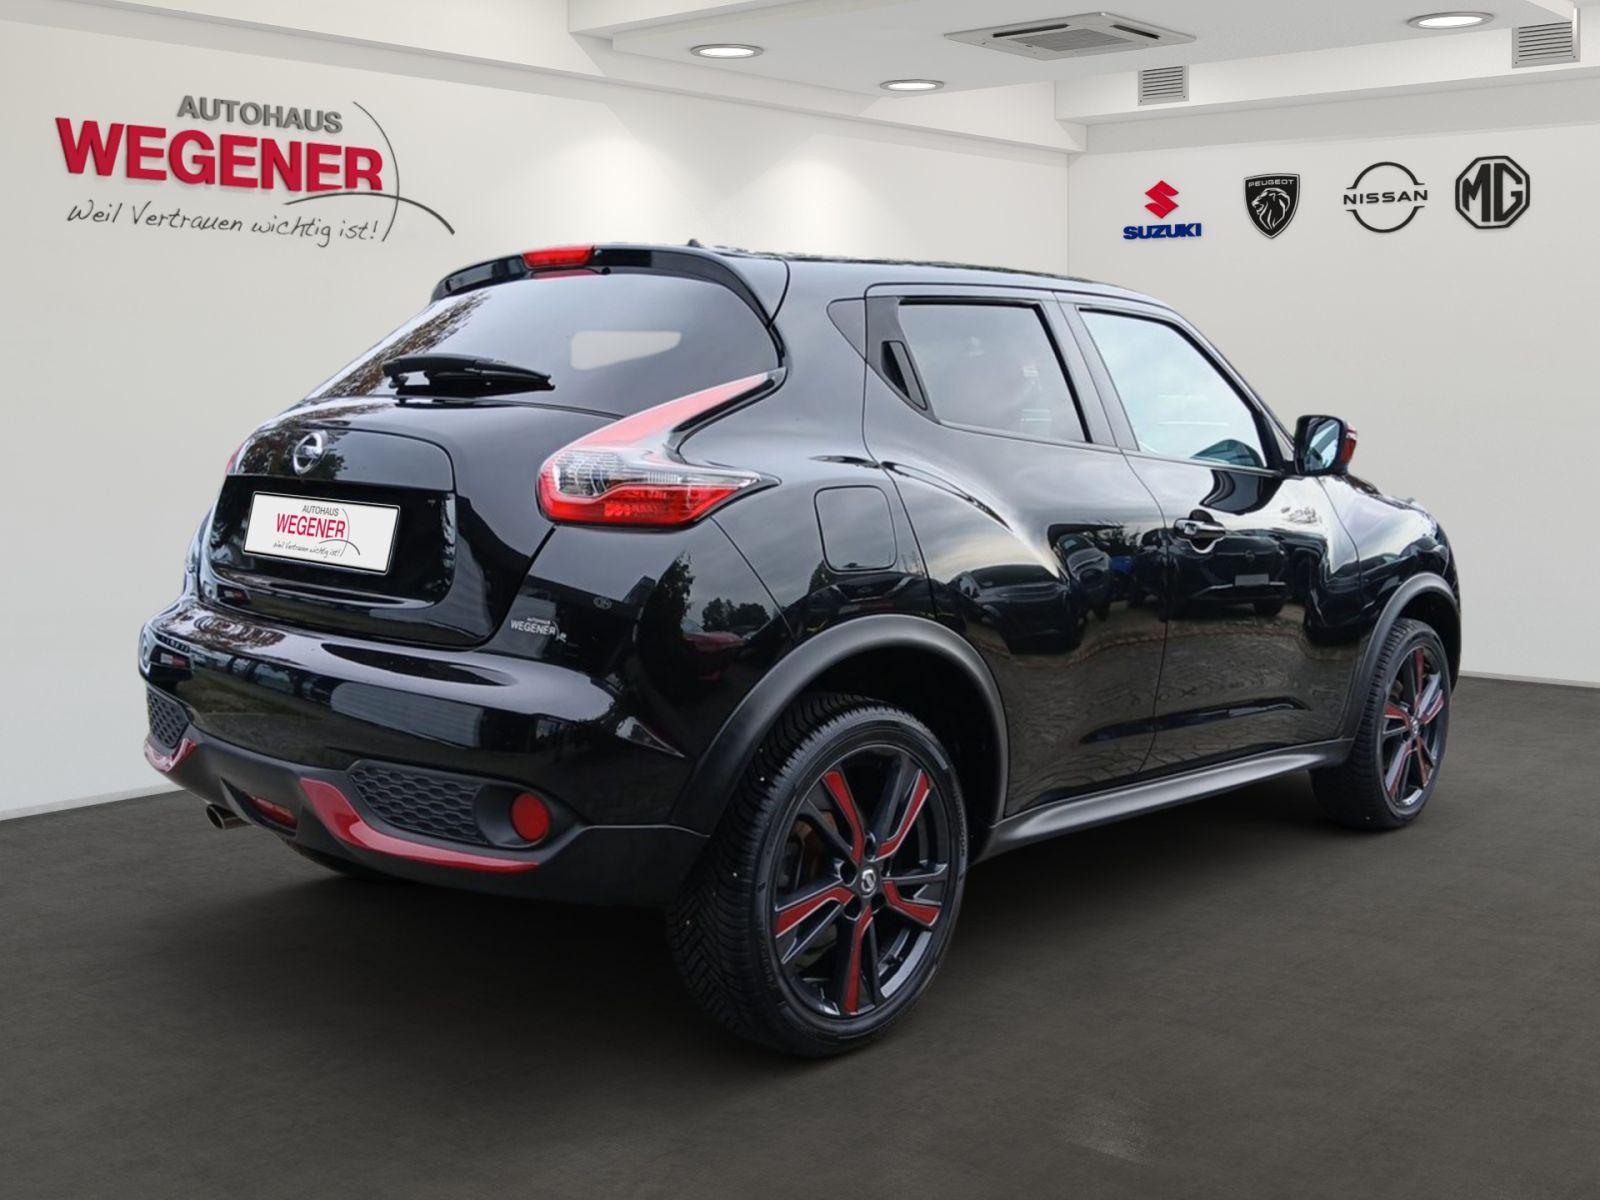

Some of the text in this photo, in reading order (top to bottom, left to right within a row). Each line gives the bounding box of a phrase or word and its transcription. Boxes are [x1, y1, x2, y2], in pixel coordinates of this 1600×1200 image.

[177, 95, 343, 134] AUTOHAUS
[55, 117, 383, 192] WEGENER
[1248, 179, 1294, 187] PEUGEOT
[1462, 162, 1524, 223] MG
[1343, 189, 1428, 205] NISSAN
[67, 200, 378, 248] Weil Vertrauen wichtig ist!
[1123, 222, 1202, 240] SUZUKI
[302, 505, 339, 517] AUTOHAUS
[276, 513, 346, 538] WEGENER
[510, 620, 556, 635] WEGENER
